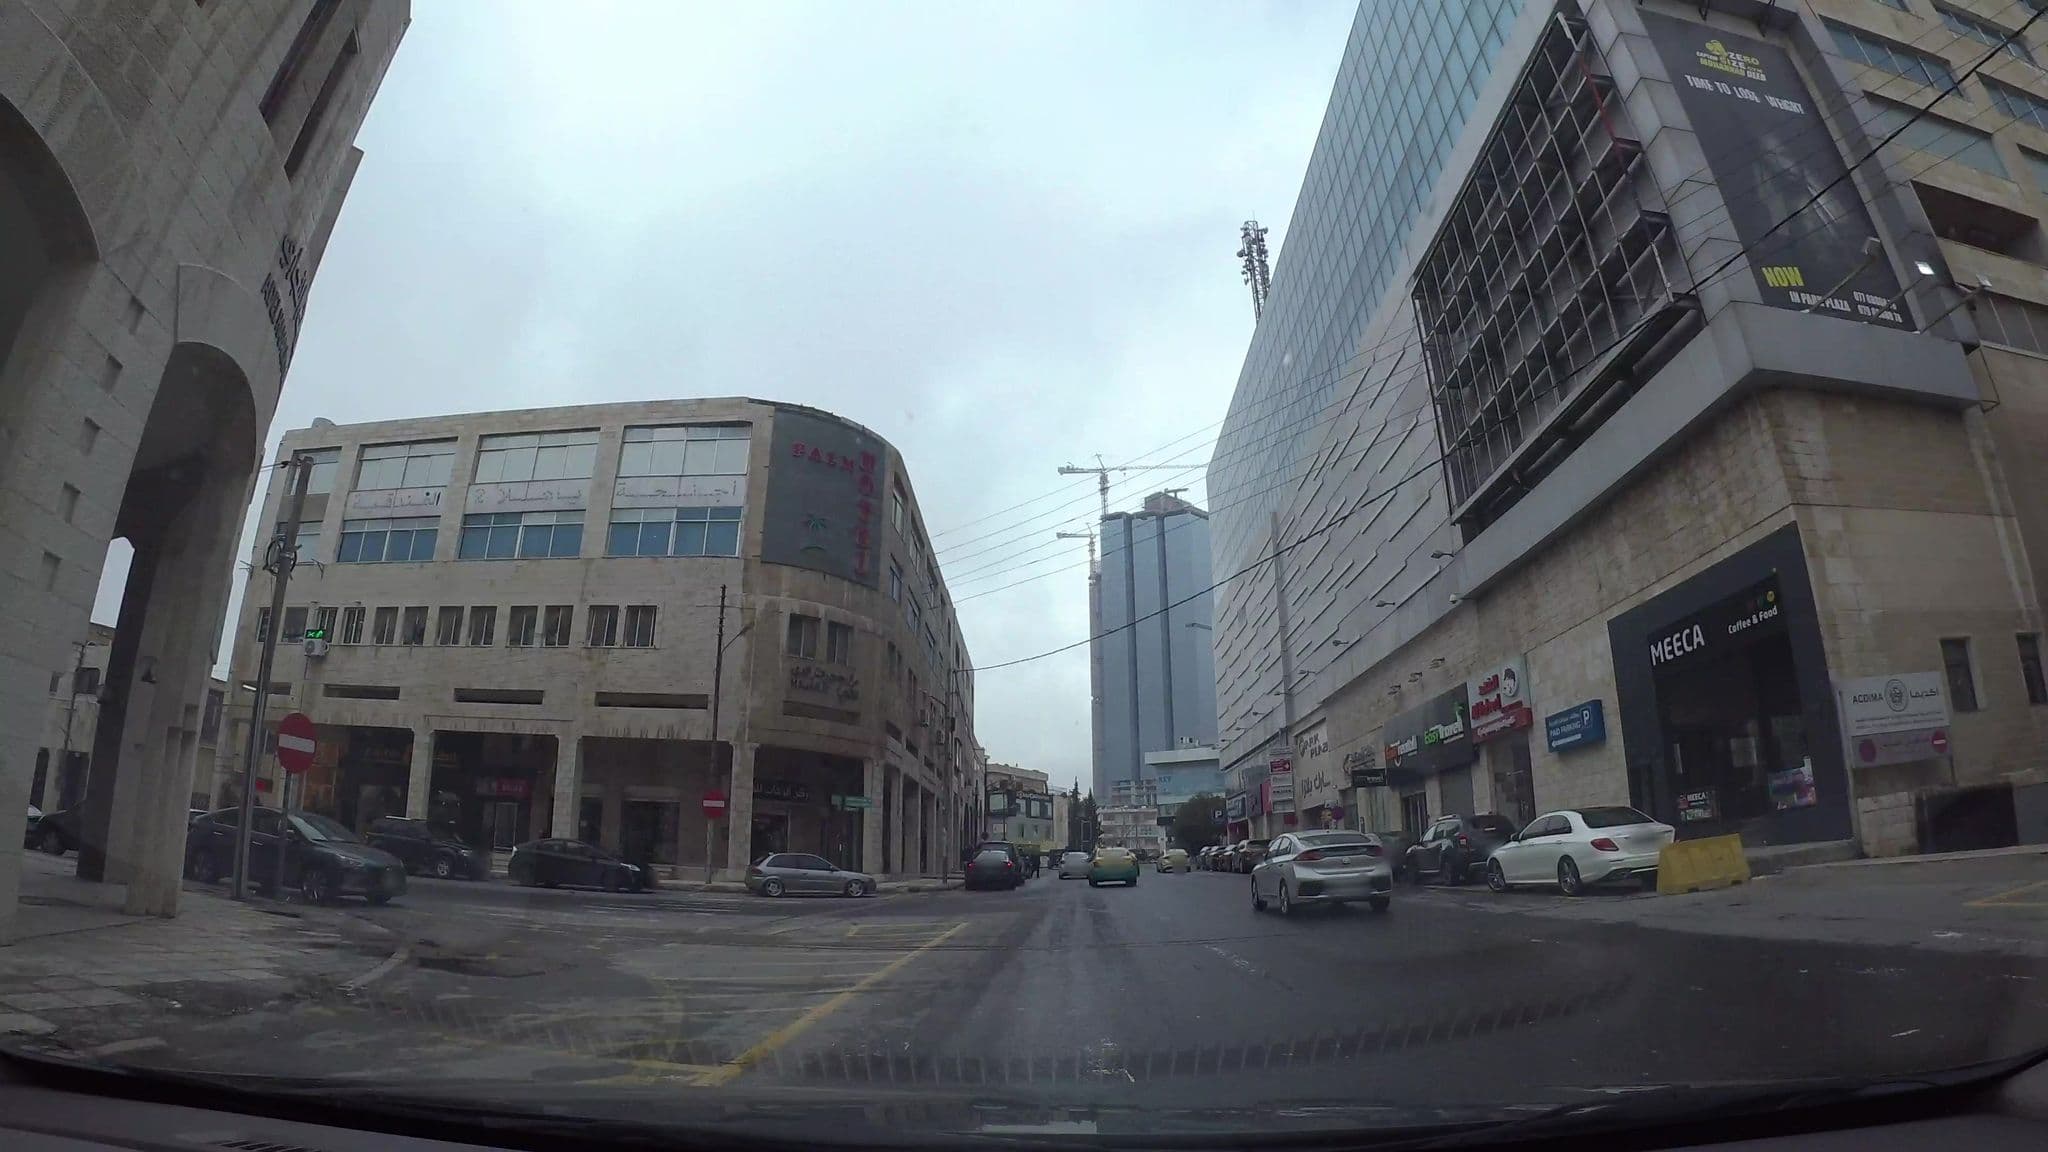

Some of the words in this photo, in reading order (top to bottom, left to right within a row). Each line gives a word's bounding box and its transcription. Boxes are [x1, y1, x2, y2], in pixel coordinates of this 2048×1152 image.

[1684, 74, 1714, 91] TIME
[1714, 81, 1731, 95] TO
[1762, 267, 1805, 288] NOW
[1727, 616, 1752, 634] Coffee
[1758, 605, 1778, 622] Food
[1650, 624, 1706, 666] MEECA
[1582, 710, 1590, 726] P
